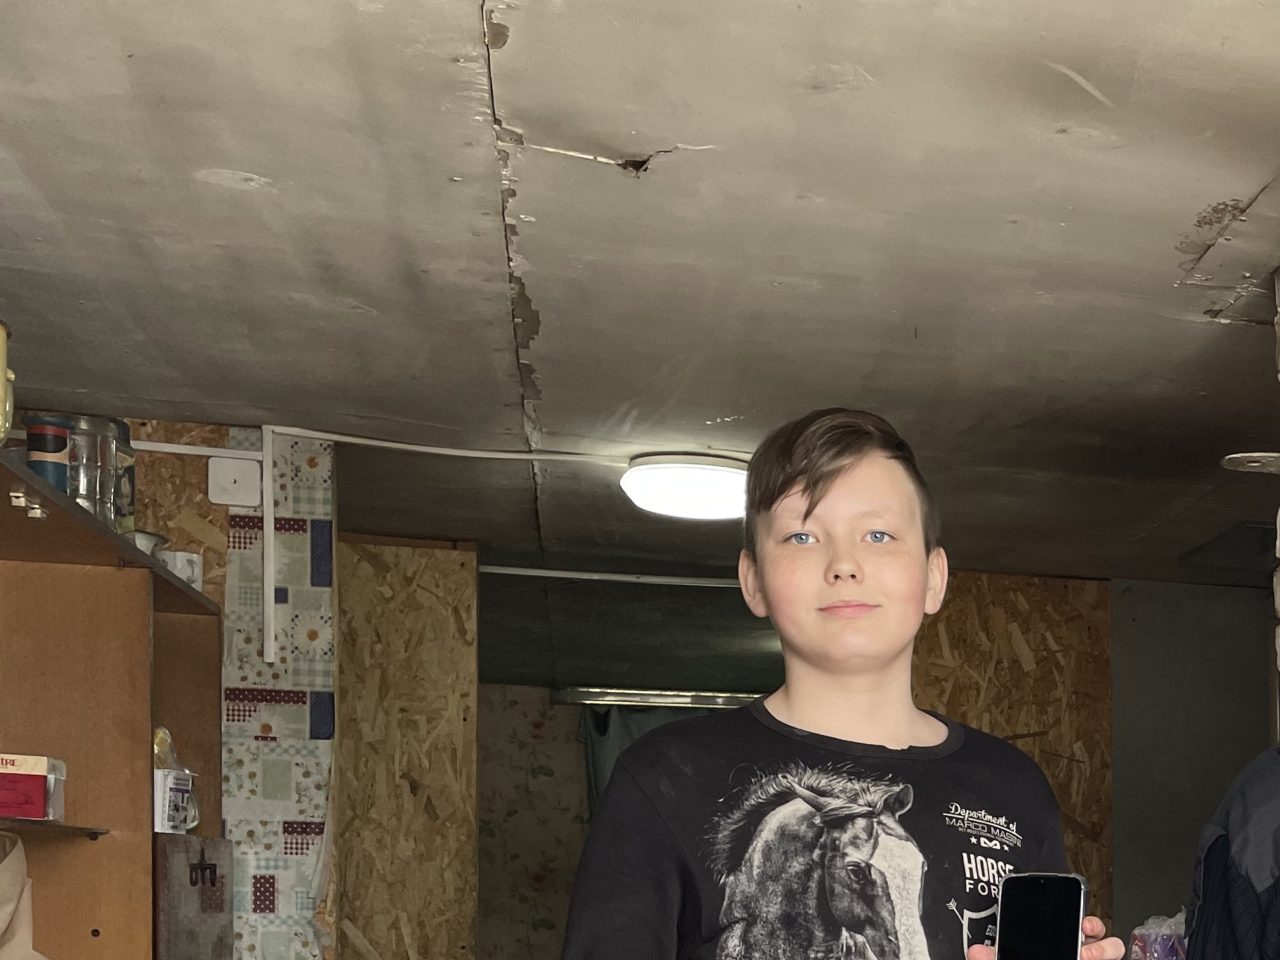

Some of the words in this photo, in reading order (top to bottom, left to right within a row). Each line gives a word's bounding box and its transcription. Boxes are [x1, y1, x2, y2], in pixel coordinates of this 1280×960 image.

[945, 817, 988, 833] MARCO
[949, 802, 1007, 826] Department
[1009, 821, 1018, 834] of
[966, 880, 999, 898] FOR
